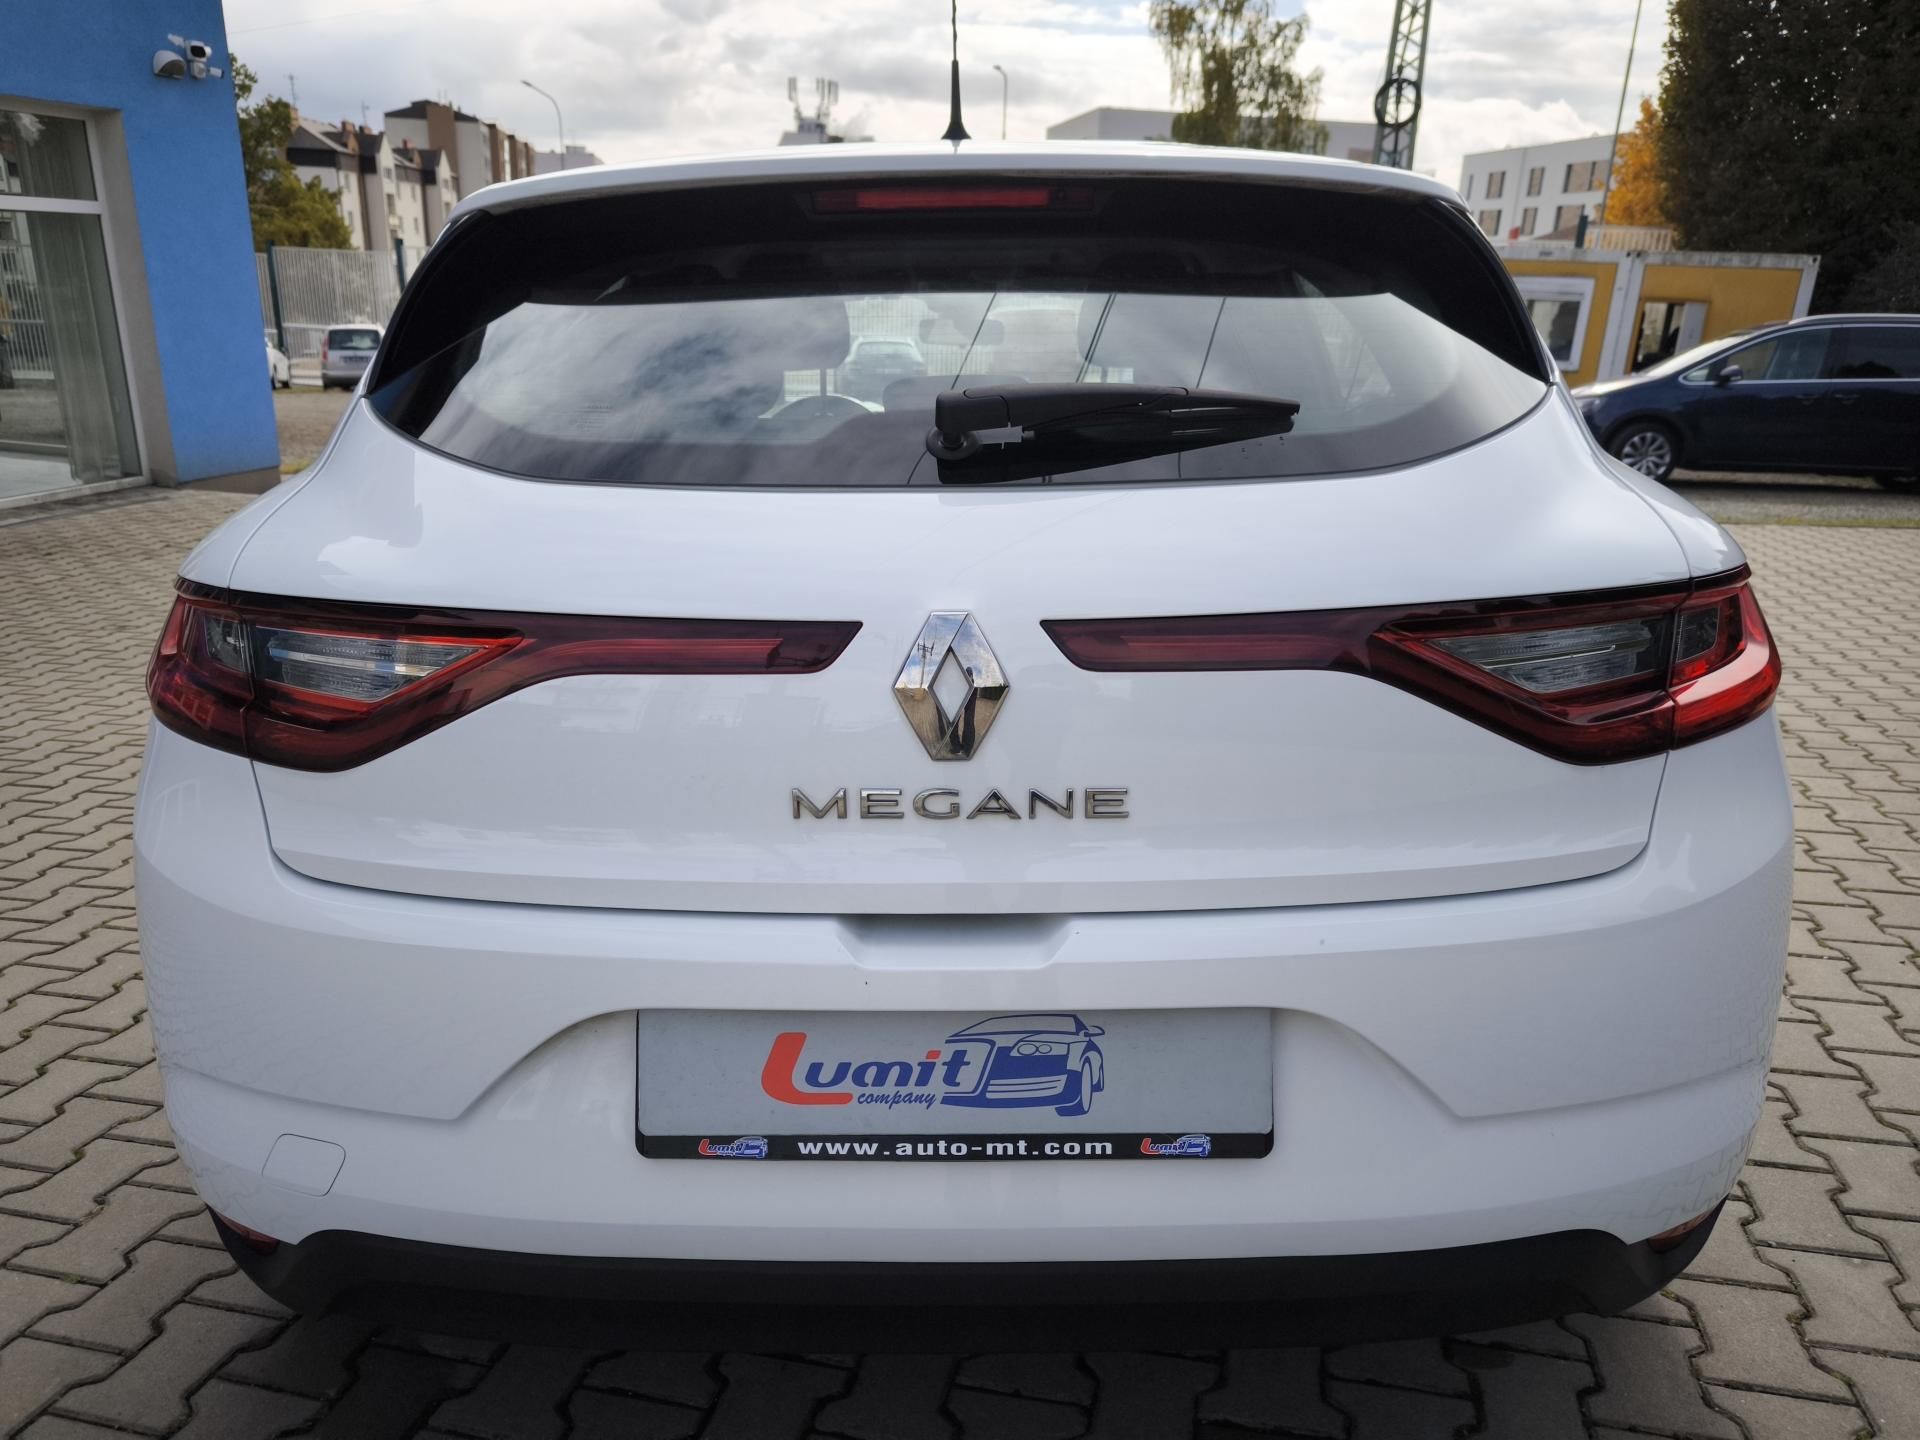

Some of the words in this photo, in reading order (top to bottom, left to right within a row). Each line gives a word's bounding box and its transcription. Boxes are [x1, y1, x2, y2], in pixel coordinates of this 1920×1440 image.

[791, 787, 1130, 820] MEGANE
[761, 1031, 971, 1105] Lumit
[857, 1089, 936, 1110] company
[797, 1139, 1114, 1156] www.auto-mt.com
